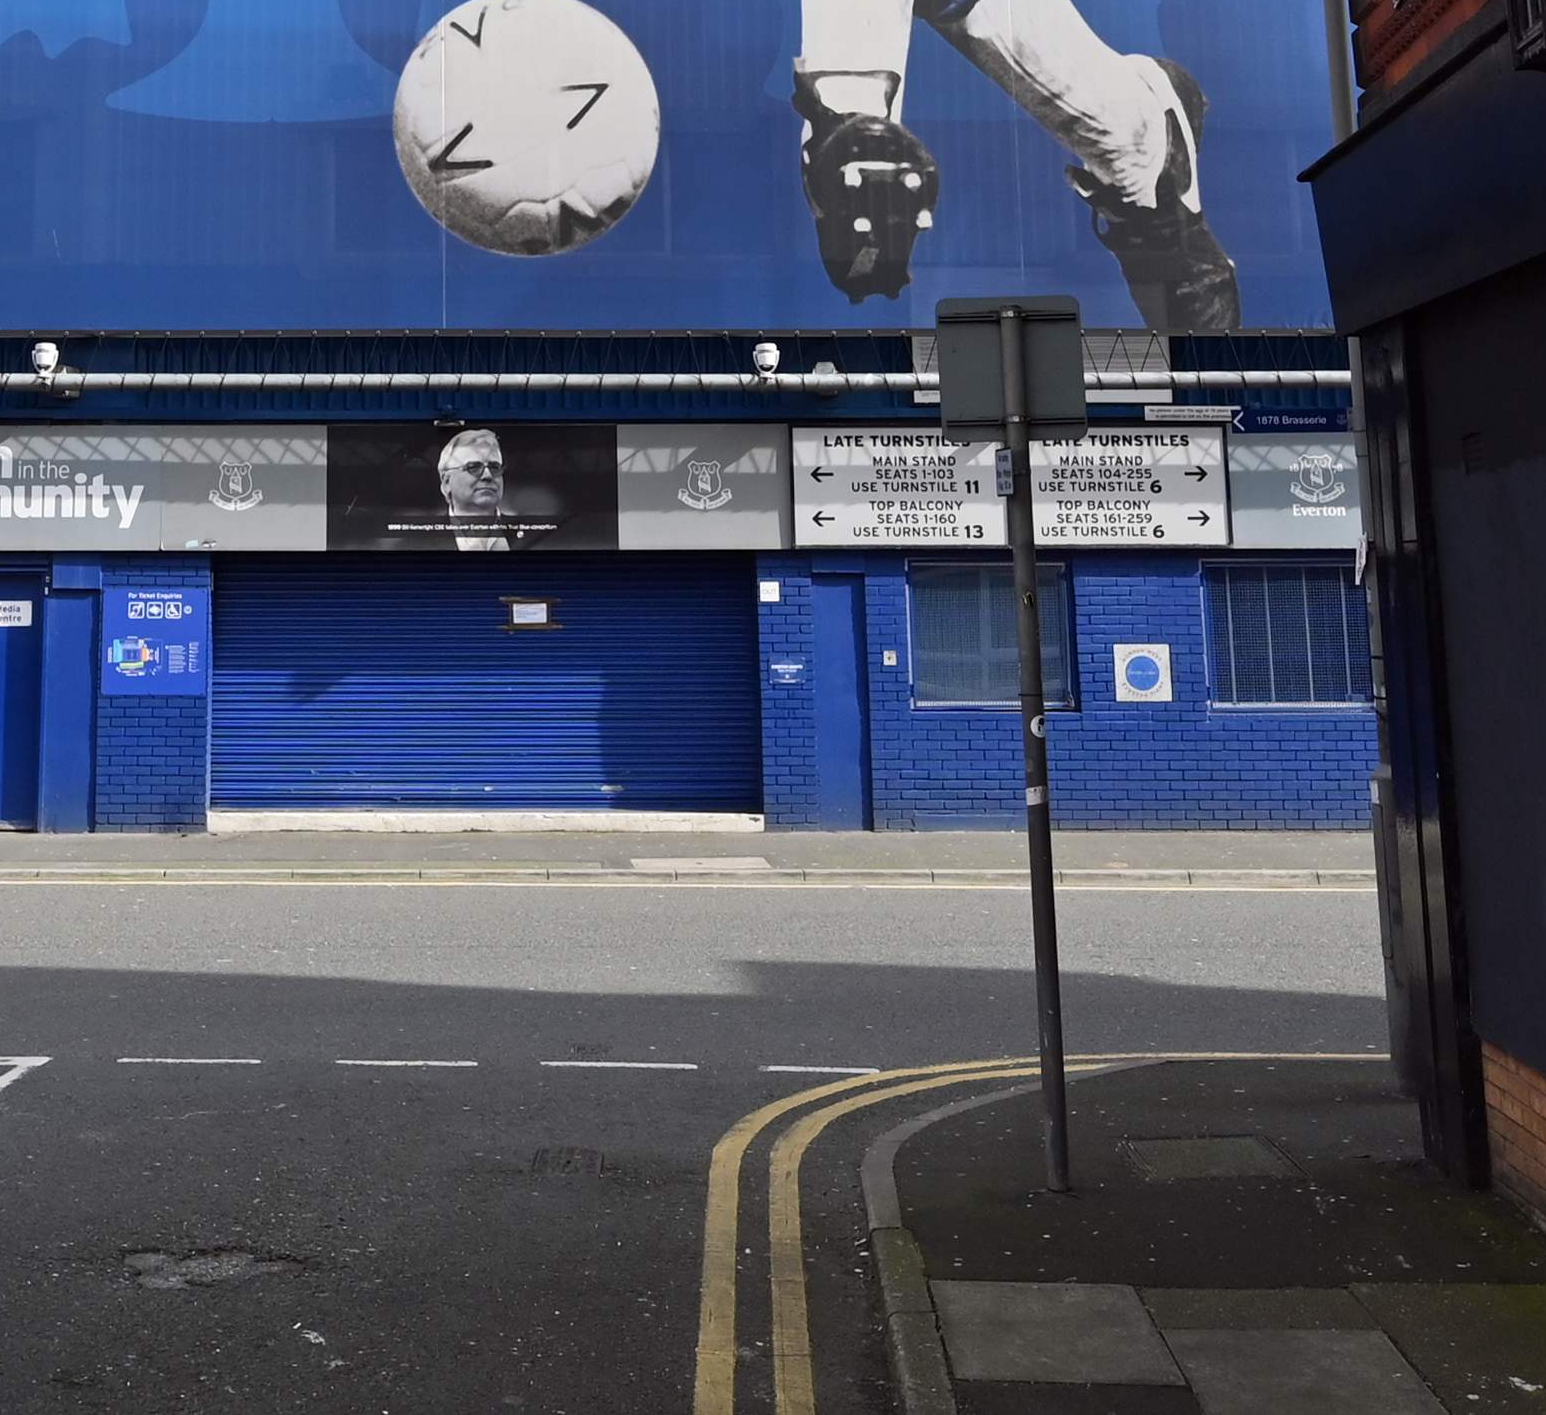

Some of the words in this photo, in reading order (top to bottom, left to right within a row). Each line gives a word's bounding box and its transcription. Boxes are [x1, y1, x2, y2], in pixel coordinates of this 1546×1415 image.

[1282, 415, 1327, 425] Brasserie
[824, 436, 864, 447] LATE
[870, 435, 971, 447] TURNSTIL
[1088, 435, 1189, 447] TURNSTILES
[873, 456, 907, 467] MAIN
[912, 456, 956, 467] STAND
[1059, 456, 1094, 466] MAIN
[1099, 456, 1143, 466] STAND
[18, 462, 34, 479] in
[39, 461, 70, 479] the
[875, 469, 918, 479] SEATS
[922, 469, 955, 479] 1-103
[1052, 469, 1094, 479] SEATS
[1098, 469, 1152, 479] 104-255
[851, 482, 878, 492] USE
[883, 482, 958, 492] TURNSTILE
[965, 480, 980, 494] 11
[1038, 482, 1065, 492] USE
[1070, 482, 1145, 492] TURNSTILE
[1150, 480, 1162, 494] 6
[869, 501, 895, 511] TOP
[900, 500, 964, 511] BALCONY
[1056, 500, 1082, 510] TOP
[1087, 500, 1151, 510] BALCONY
[1292, 504, 1346, 517] Everton
[877, 514, 919, 524] SEATS
[924, 514, 957, 524] 1-160
[1057, 514, 1099, 524] SEATS
[1104, 513, 1153, 523] 161-259
[853, 527, 880, 537] USE
[884, 527, 959, 537] TURNSTILE
[964, 525, 984, 538] 13
[1041, 526, 1068, 537] USE
[1072, 526, 1147, 537] TURNSTILE
[1153, 525, 1165, 538] 6
